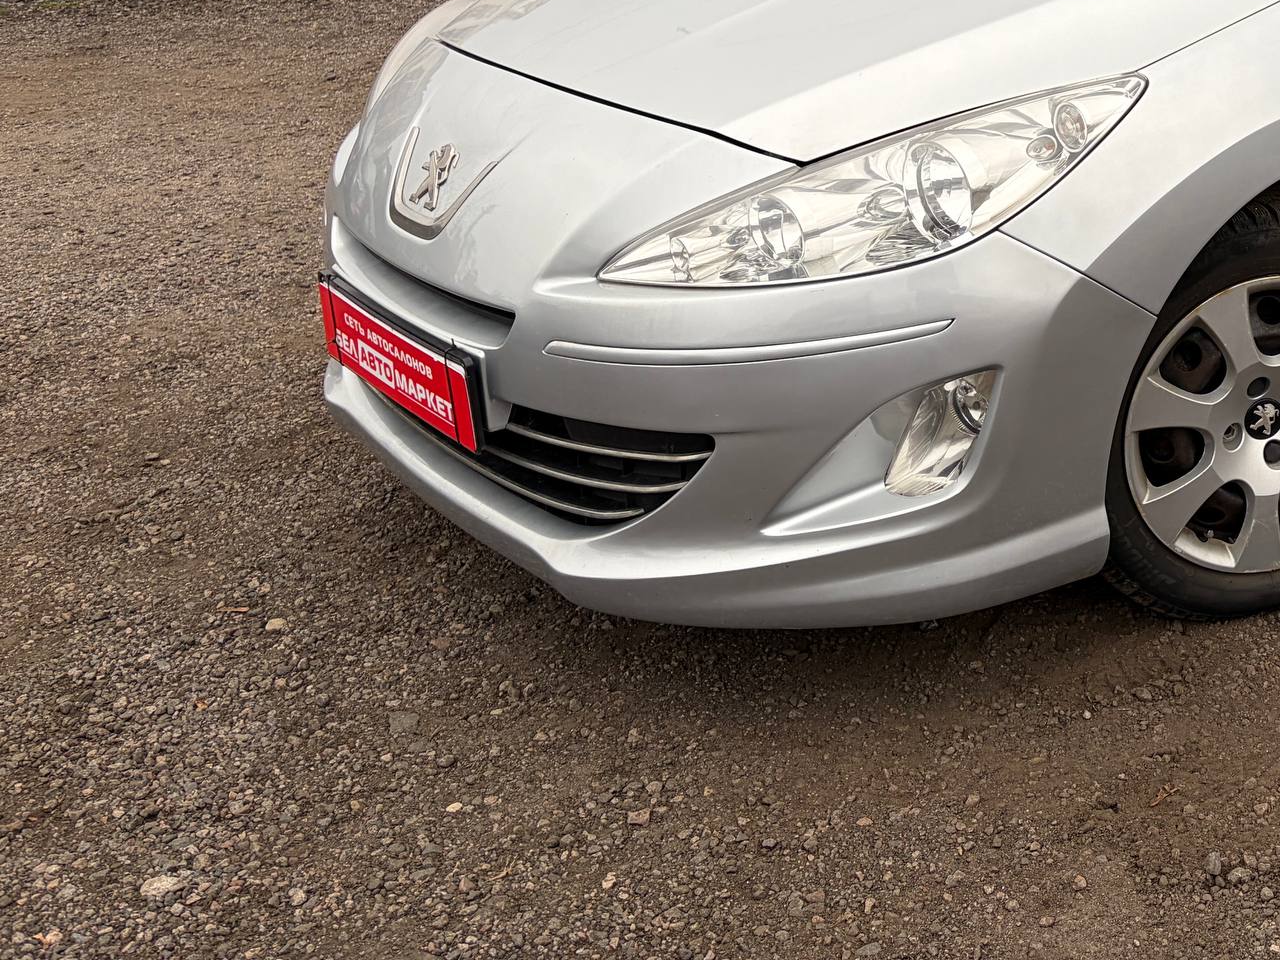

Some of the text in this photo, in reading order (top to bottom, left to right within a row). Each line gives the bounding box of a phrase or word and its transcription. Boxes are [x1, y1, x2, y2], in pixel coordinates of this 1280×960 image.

[343, 312, 434, 381] СЕТЬ АВТОСАЛОНОВ
[360, 342, 393, 383] АВТО
[394, 368, 454, 422] МАРКЕТ
